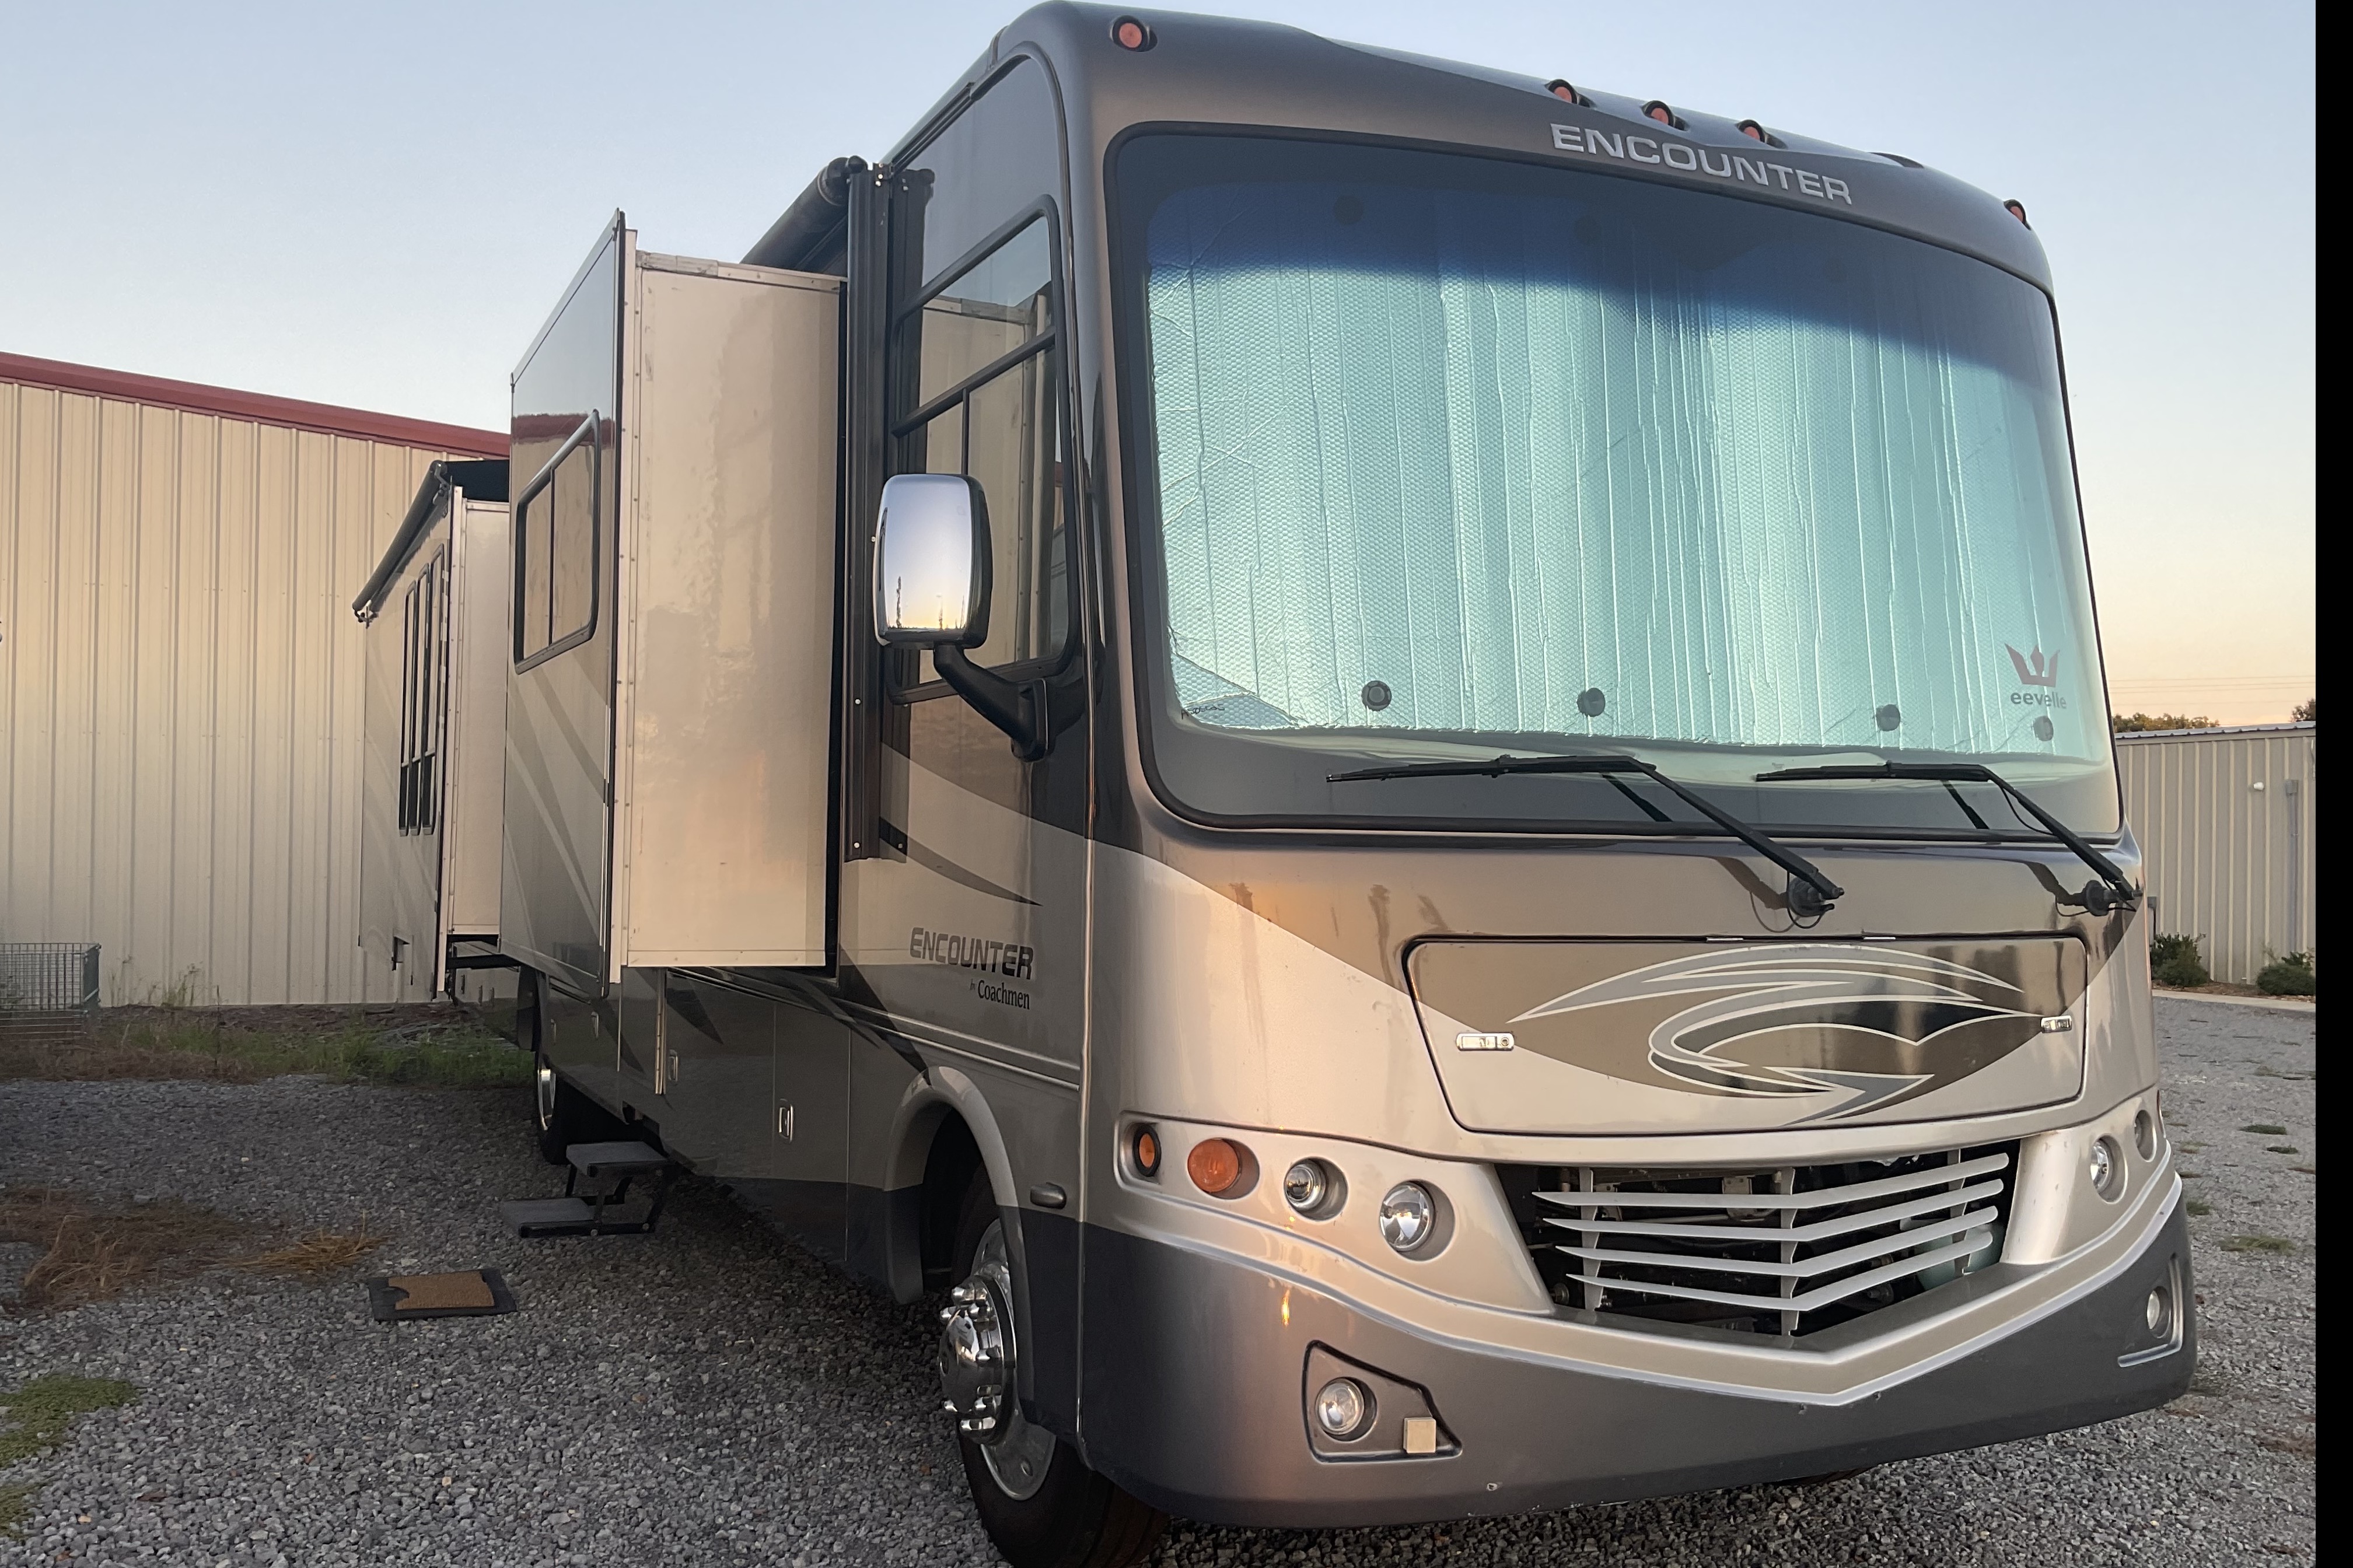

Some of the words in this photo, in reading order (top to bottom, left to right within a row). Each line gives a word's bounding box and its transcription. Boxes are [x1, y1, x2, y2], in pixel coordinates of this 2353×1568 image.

[1550, 123, 1852, 205] ENCOUNTER
[2010, 692, 2067, 709] eevelle
[910, 927, 1034, 980] ENCOUNTER
[978, 980, 1030, 1010] Coachmen
